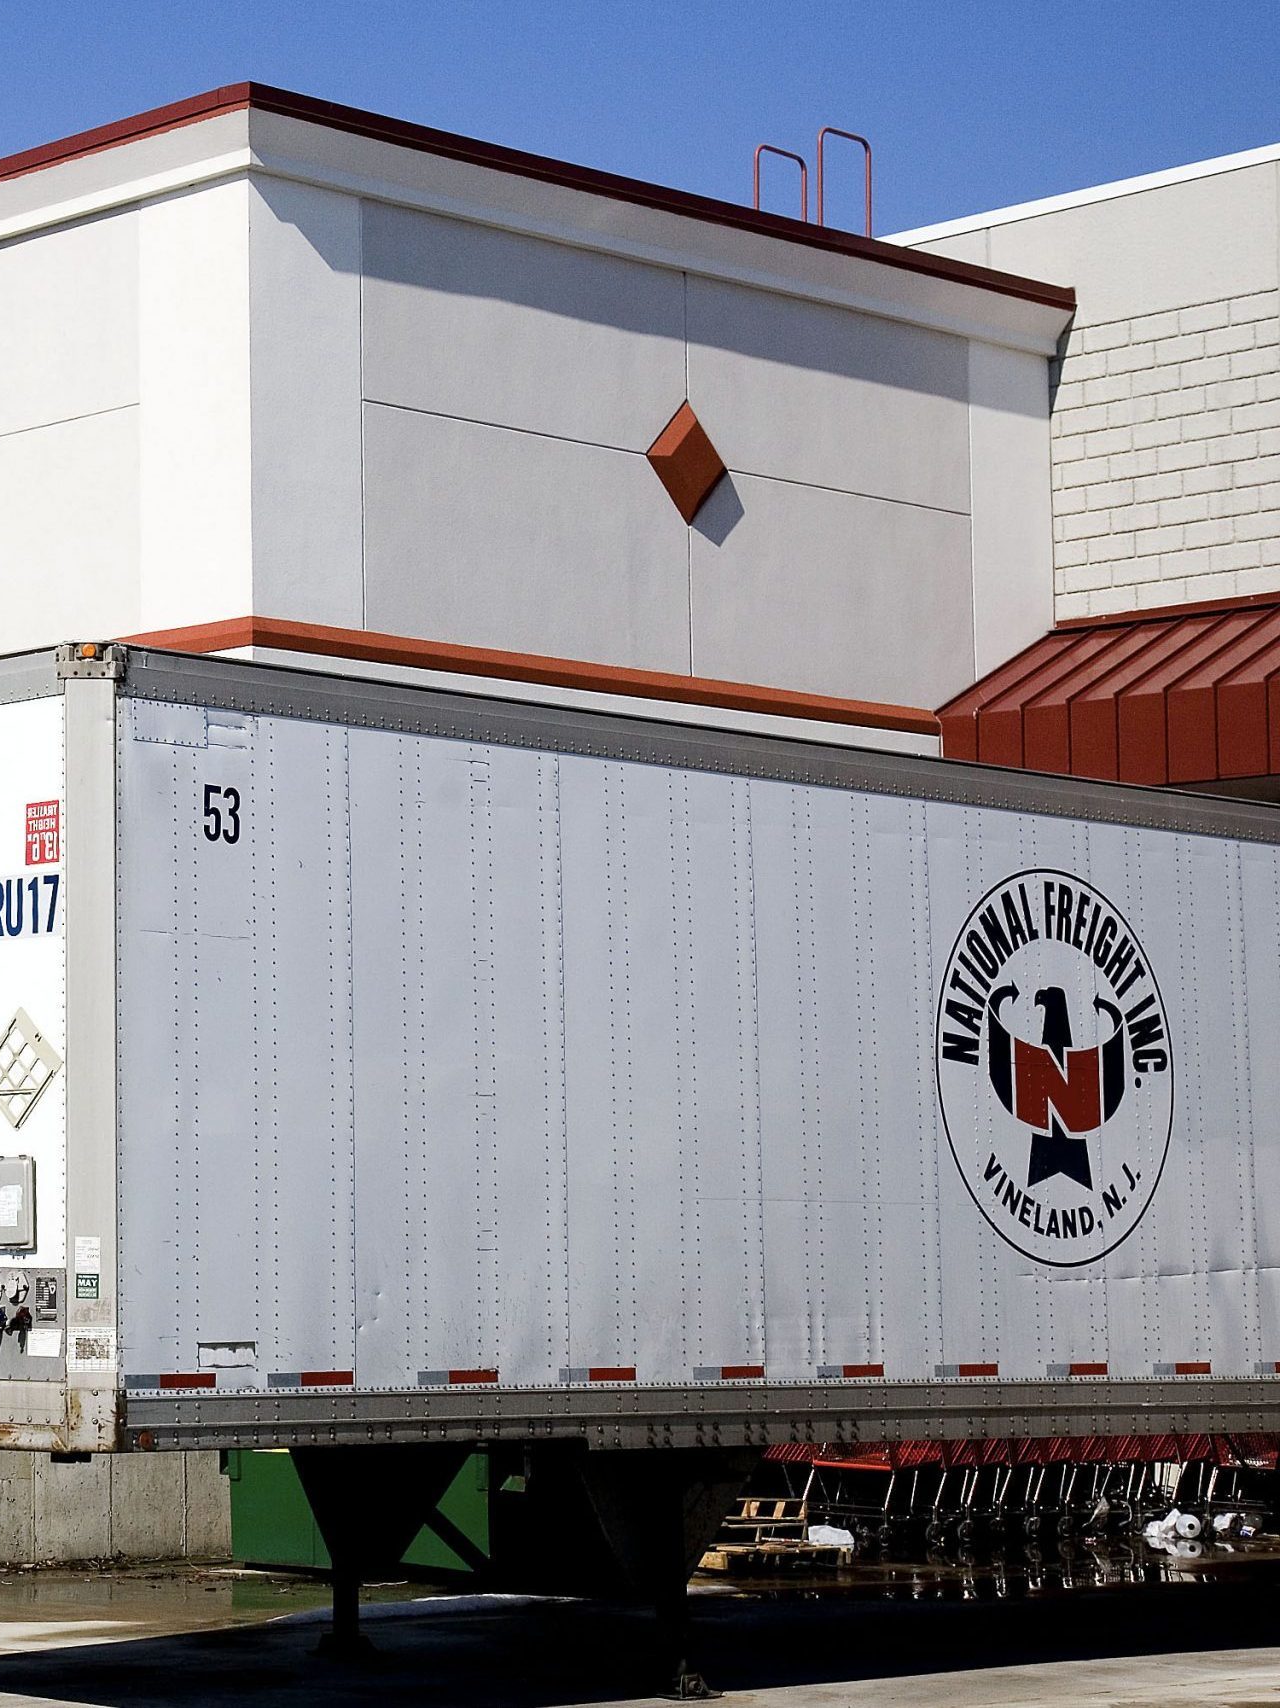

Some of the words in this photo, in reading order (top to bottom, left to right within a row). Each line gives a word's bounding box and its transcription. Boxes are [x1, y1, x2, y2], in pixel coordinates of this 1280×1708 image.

[203, 783, 241, 845] 53
[942, 883, 1039, 1067] NATIONAL
[1043, 880, 1147, 1001] FREIGHT
[1124, 992, 1168, 1089] INC.
[982, 1152, 1104, 1240] VINELAND,
[77, 1279, 98, 1287] MAY
